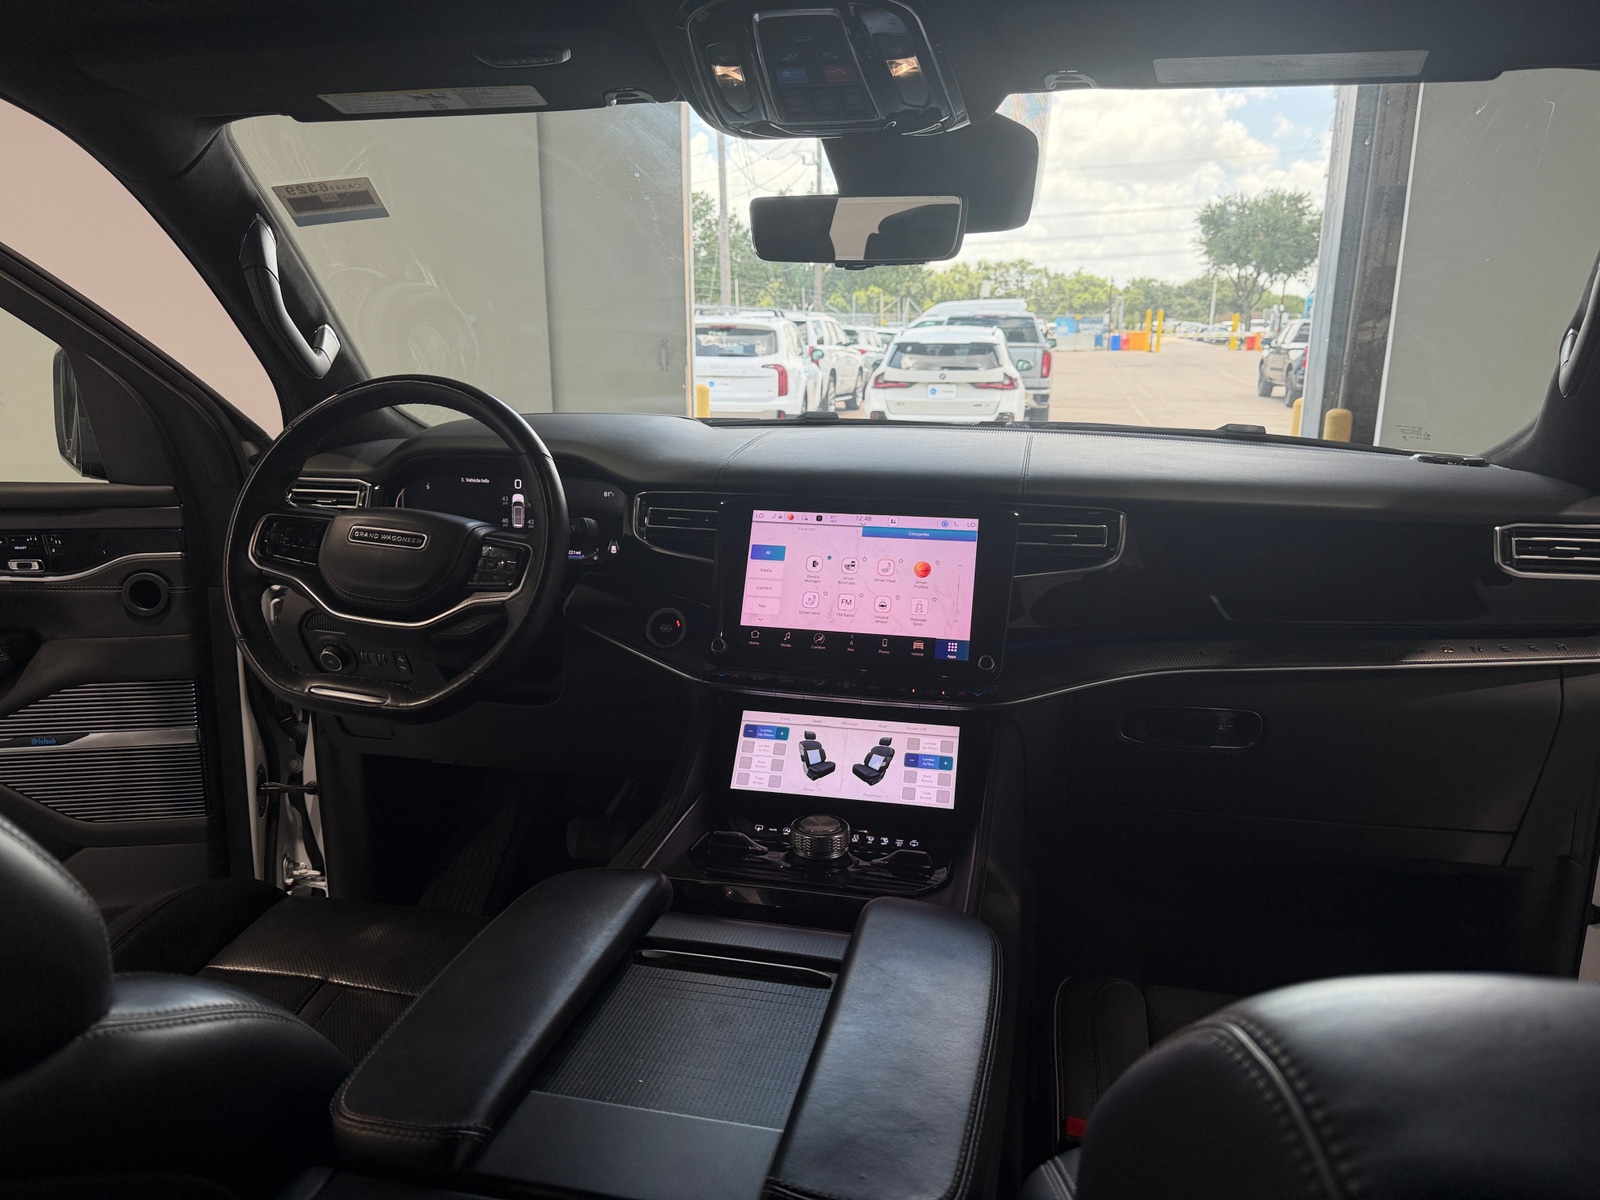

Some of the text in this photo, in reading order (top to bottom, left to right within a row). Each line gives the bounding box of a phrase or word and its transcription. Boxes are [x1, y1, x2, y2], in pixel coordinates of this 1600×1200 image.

[514, 479, 522, 489] 0
[354, 531, 422, 545] GRAND WAGONEER
